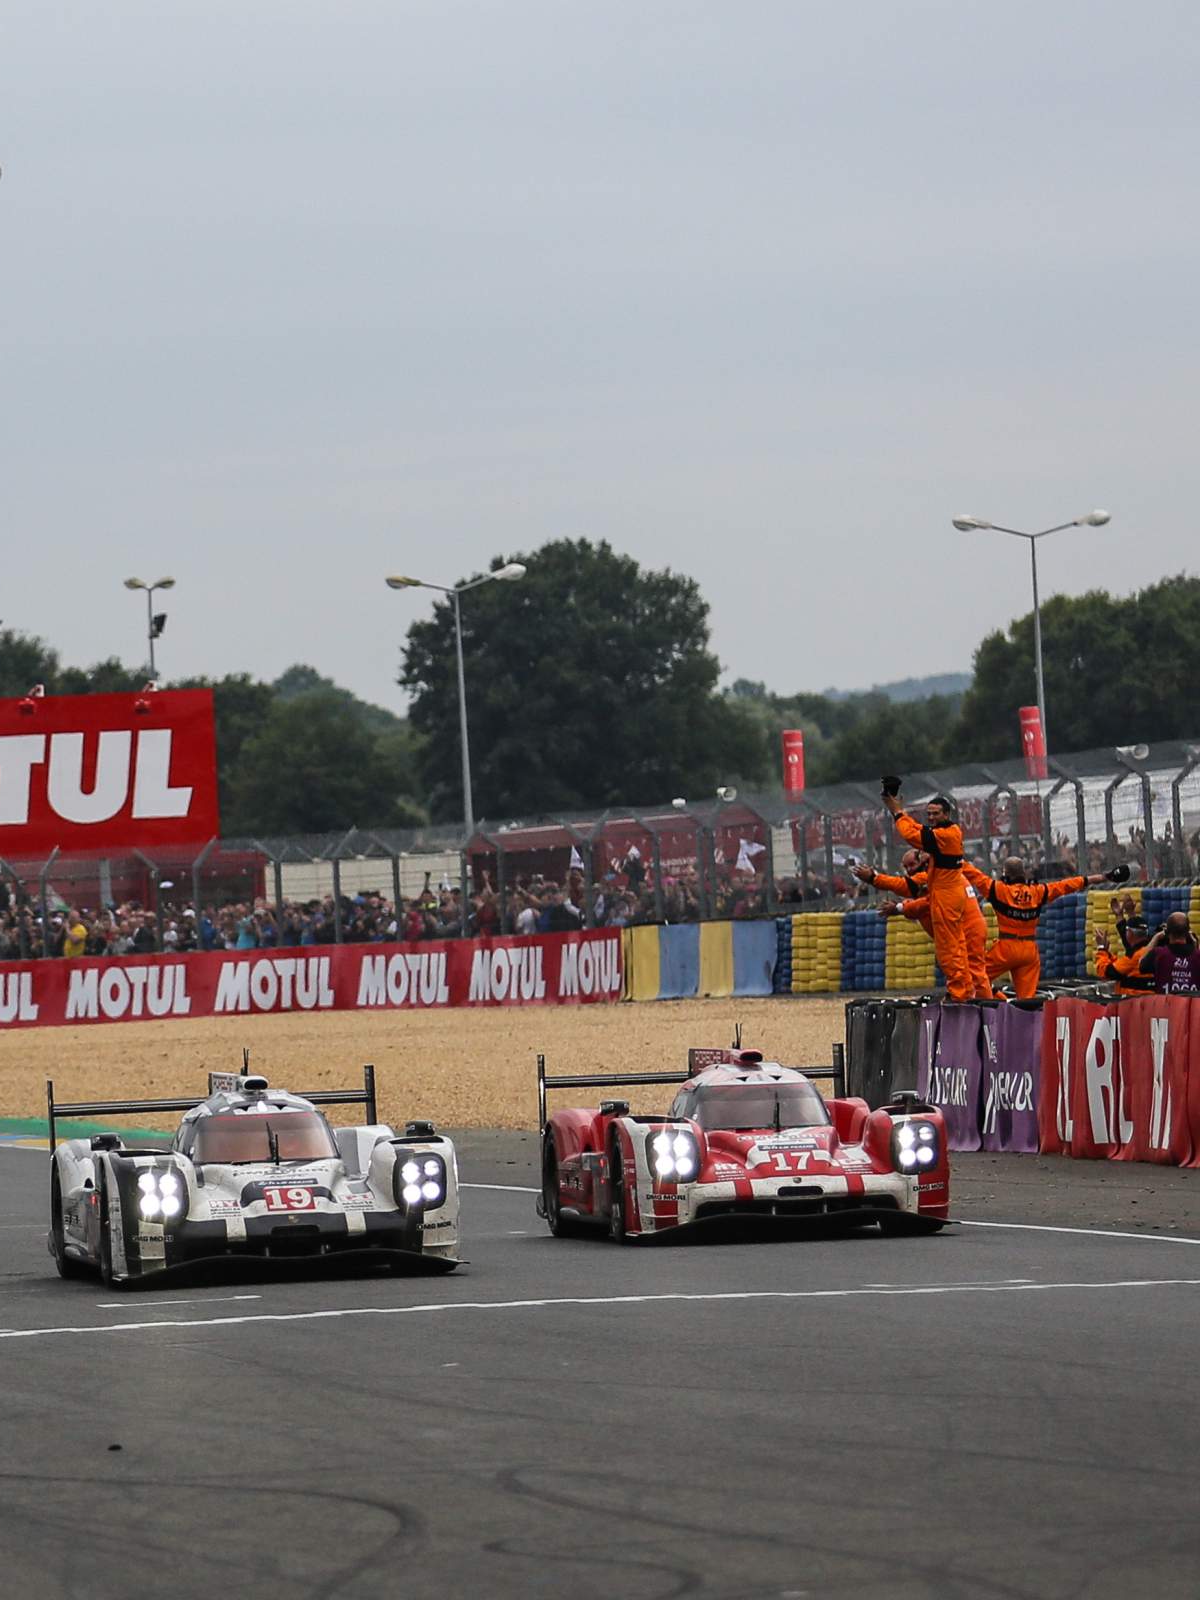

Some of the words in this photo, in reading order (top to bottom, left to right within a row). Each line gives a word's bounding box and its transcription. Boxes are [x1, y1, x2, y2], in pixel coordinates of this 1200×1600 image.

[65, 964, 191, 1019] MOTUL
[214, 956, 335, 1012] MOTUL
[357, 952, 449, 1006] MOTUL
[469, 946, 546, 1001] MOTUL
[559, 939, 621, 996] MOTUL
[771, 1152, 811, 1171] 17
[266, 1188, 312, 1209] 19
